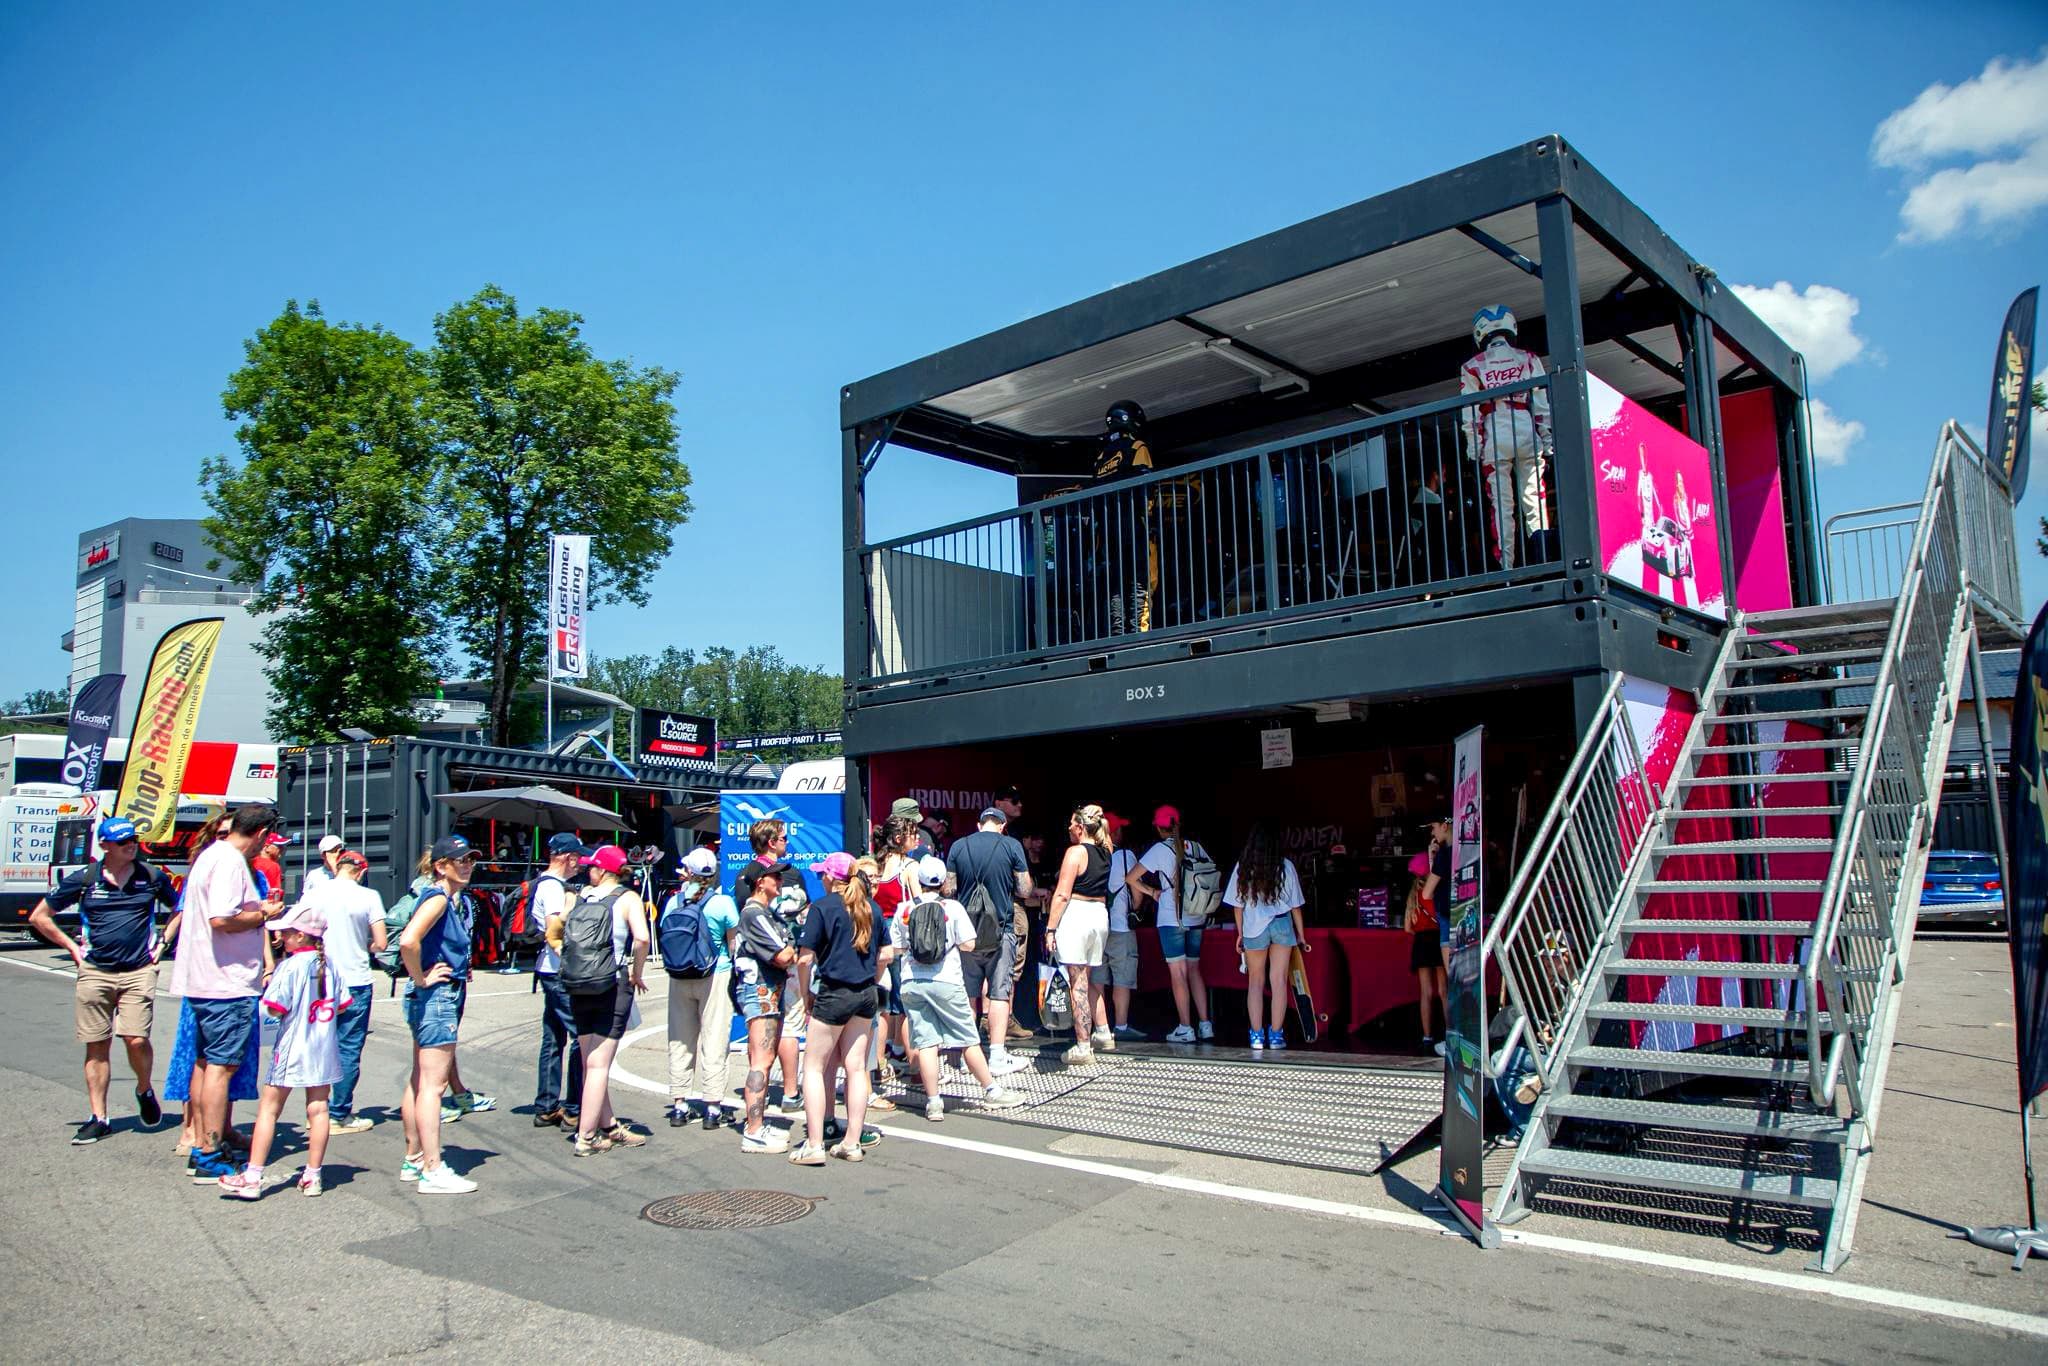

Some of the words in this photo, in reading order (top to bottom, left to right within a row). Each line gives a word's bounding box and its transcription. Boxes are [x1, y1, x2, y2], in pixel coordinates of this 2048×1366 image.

[1486, 365, 1524, 382] EVERY
[557, 542, 571, 629] Customer
[570, 566, 584, 632] Racing
[1126, 686, 1154, 701] BOX
[1157, 685, 1165, 698] 3
[677, 722, 698, 733] OPEN
[124, 640, 197, 835] Shop-Racing.com
[667, 731, 698, 742] SOURCE
[761, 736, 792, 747] ROOFTOP
[792, 735, 815, 745] PARTY
[168, 743, 187, 797] Acquisition
[908, 788, 955, 808] IRON
[30, 825, 54, 833] Rad
[30, 839, 52, 847] Dat
[29, 853, 50, 861] Vid
[728, 853, 750, 861] YOUR
[794, 852, 817, 860] SHOP
[818, 852, 830, 860] FO
